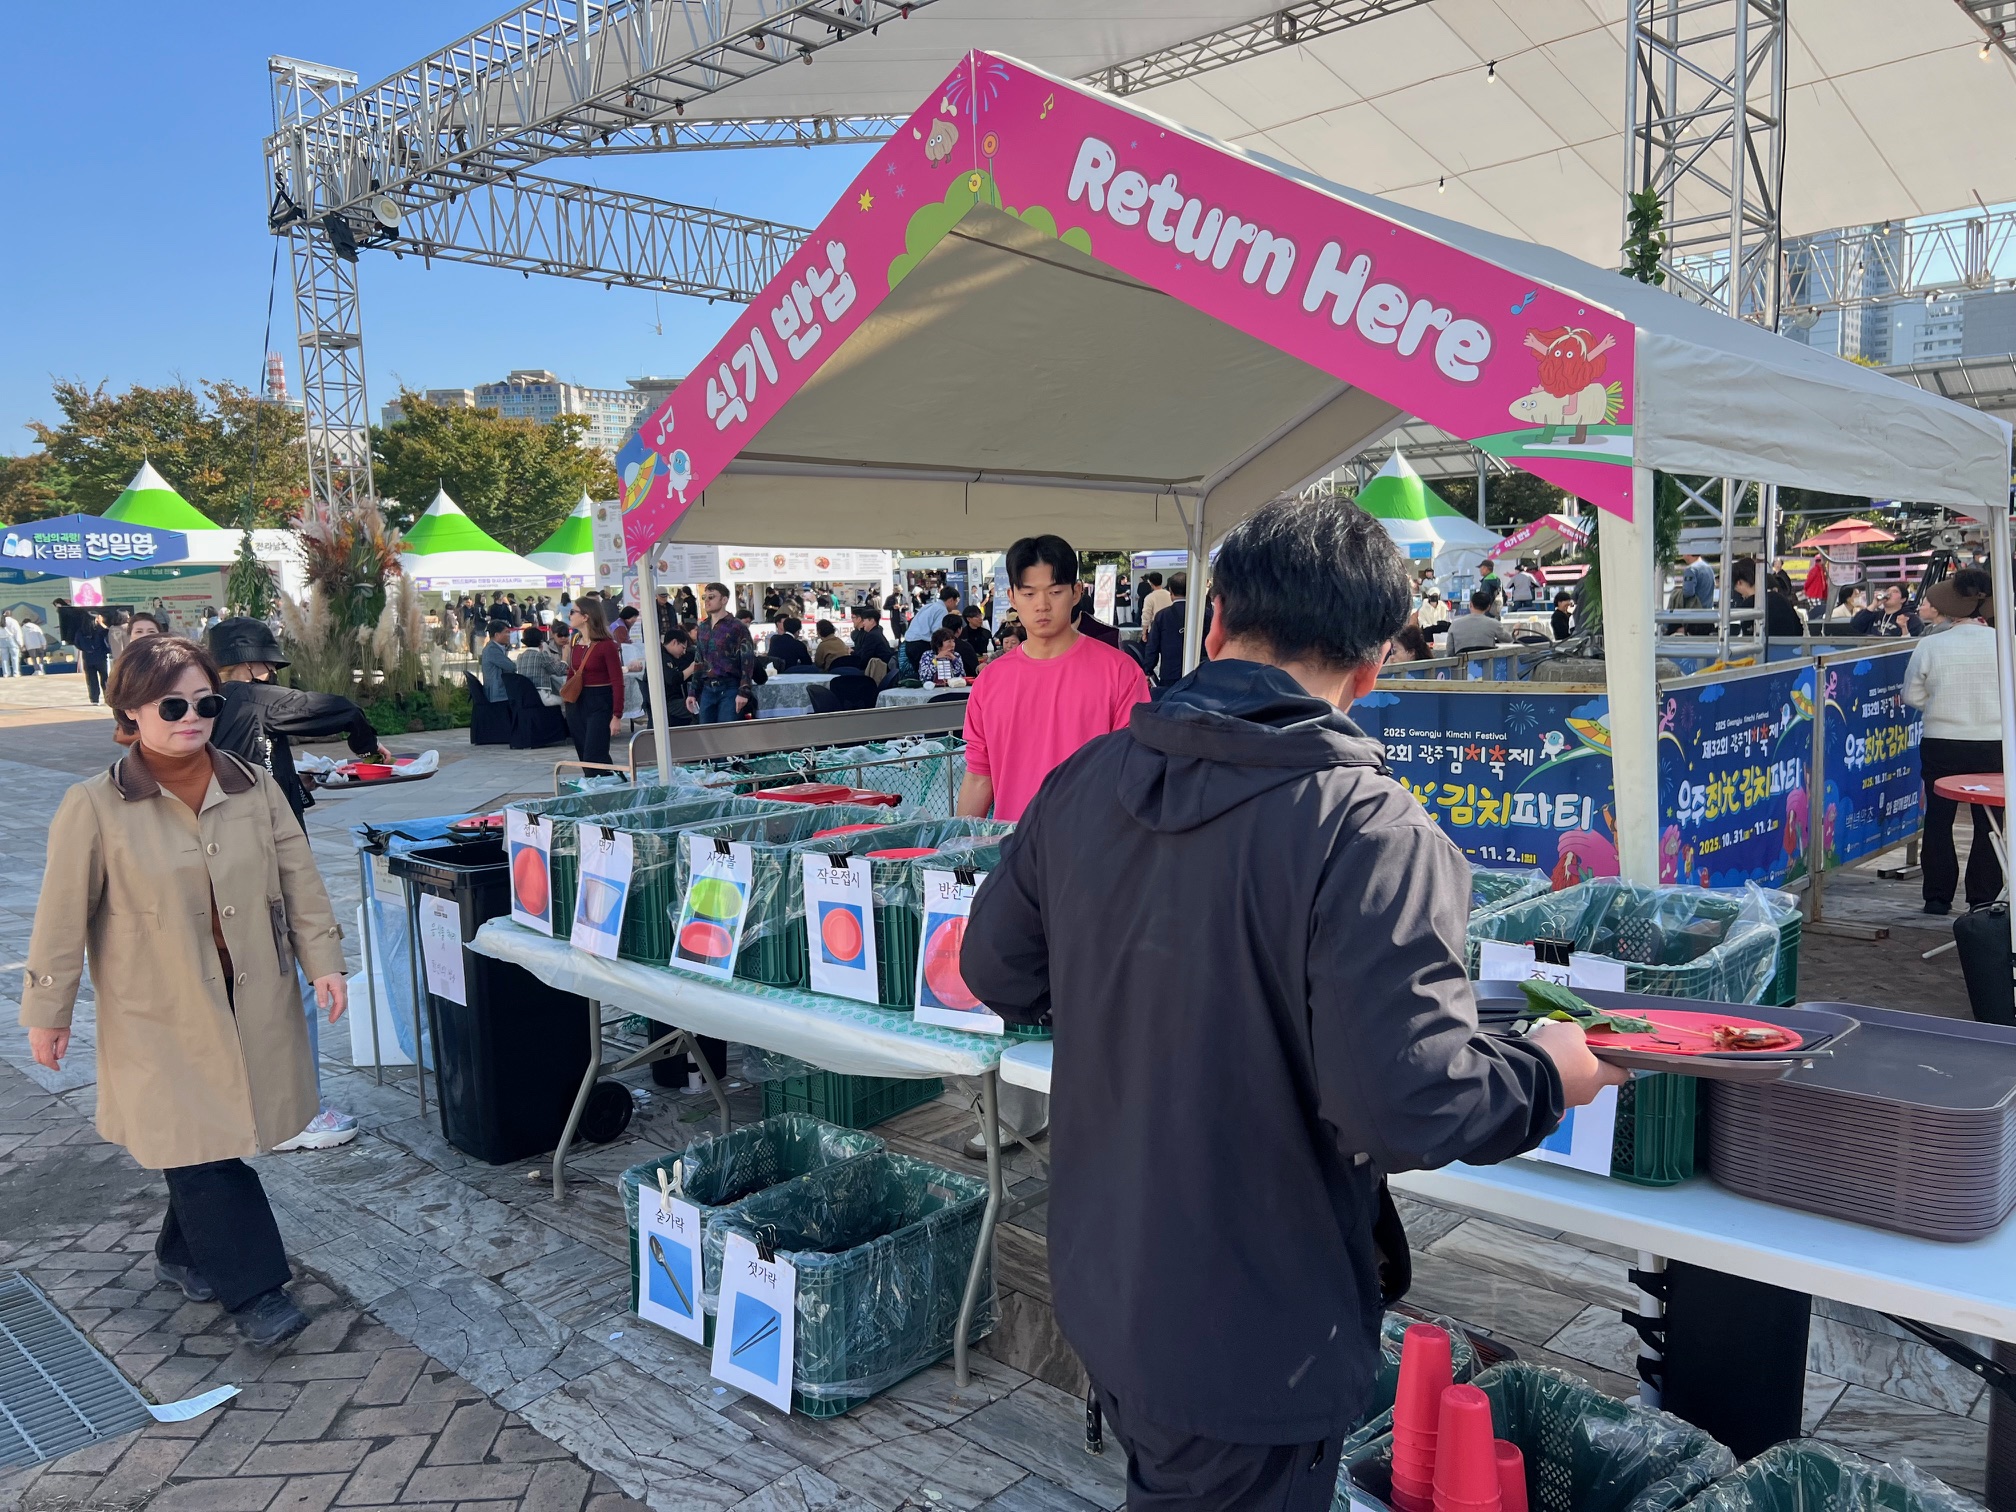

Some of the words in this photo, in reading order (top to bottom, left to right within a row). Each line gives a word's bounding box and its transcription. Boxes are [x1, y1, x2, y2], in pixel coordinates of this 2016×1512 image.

[1067, 136, 1297, 295] Return
[1302, 240, 1492, 382] Here
[706, 326, 779, 431] 식기
[770, 239, 858, 362] 반납
[34, 544, 82, 559] K-명품
[85, 532, 158, 556] 천일염
[1383, 728, 1406, 738] 2025
[1408, 728, 1442, 740] Gwangju
[1445, 730, 1472, 739] Kimchi
[1475, 731, 1508, 741] Festival
[1715, 719, 1726, 732] 2025
[1385, 744, 1412, 763] 2회
[1702, 736, 1728, 759] 제32회
[1480, 846, 1502, 860] 11.
[1699, 836, 1721, 856] 2025.
[1722, 832, 1732, 848] 10.
[706, 850, 737, 870] 사각볼
[817, 867, 861, 889] 작은접시
[938, 880, 976, 901] 반찬그
[655, 1207, 685, 1234] 숟가락
[747, 1259, 778, 1290] 젓가락
